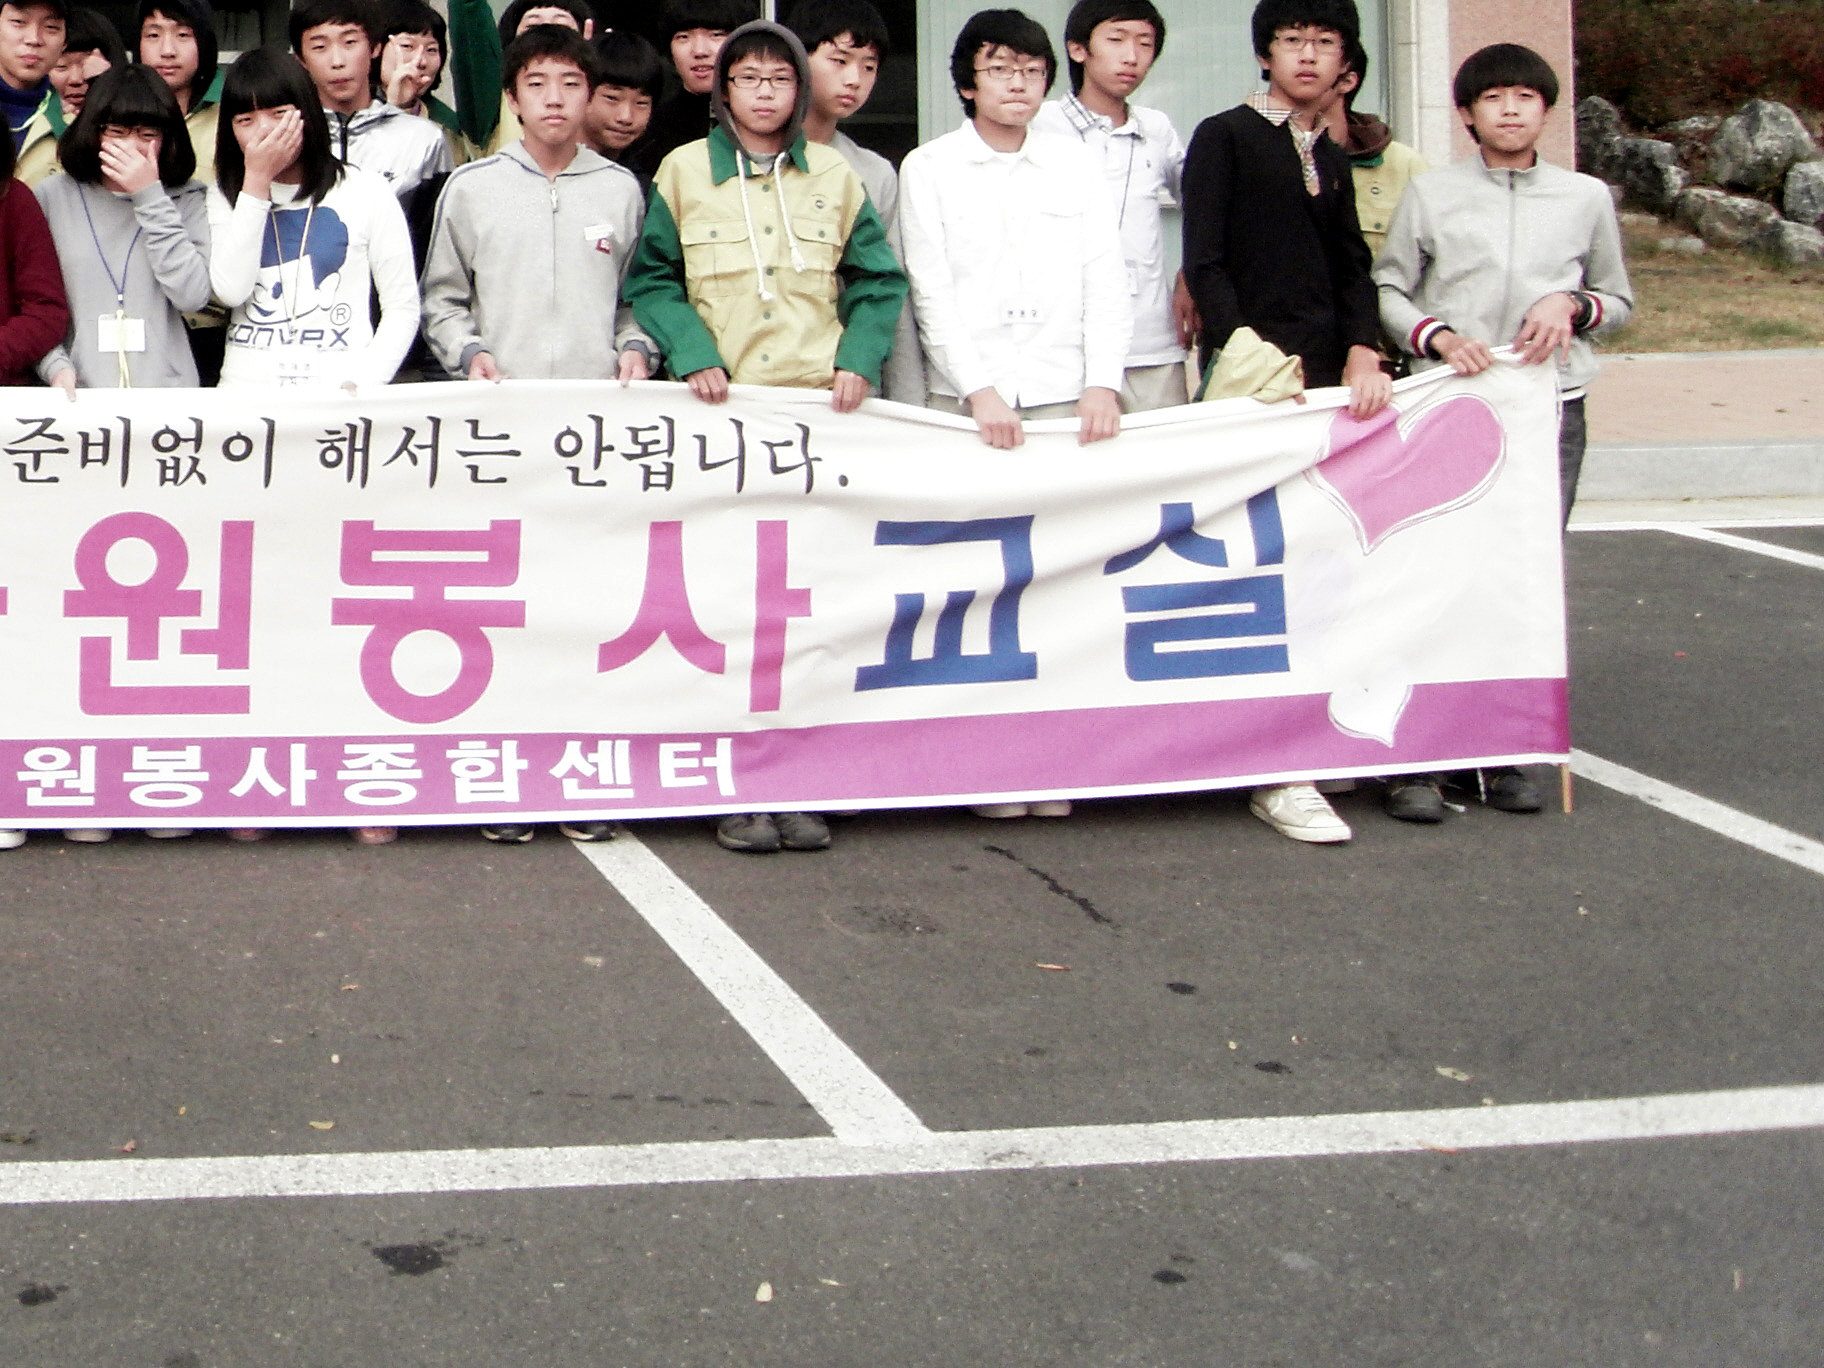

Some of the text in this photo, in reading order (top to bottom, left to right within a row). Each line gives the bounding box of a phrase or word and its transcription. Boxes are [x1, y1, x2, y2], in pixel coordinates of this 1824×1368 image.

[2, 415, 276, 489] 준비없이
[316, 415, 522, 490] 해서는
[553, 413, 849, 494] 안됩니다.
